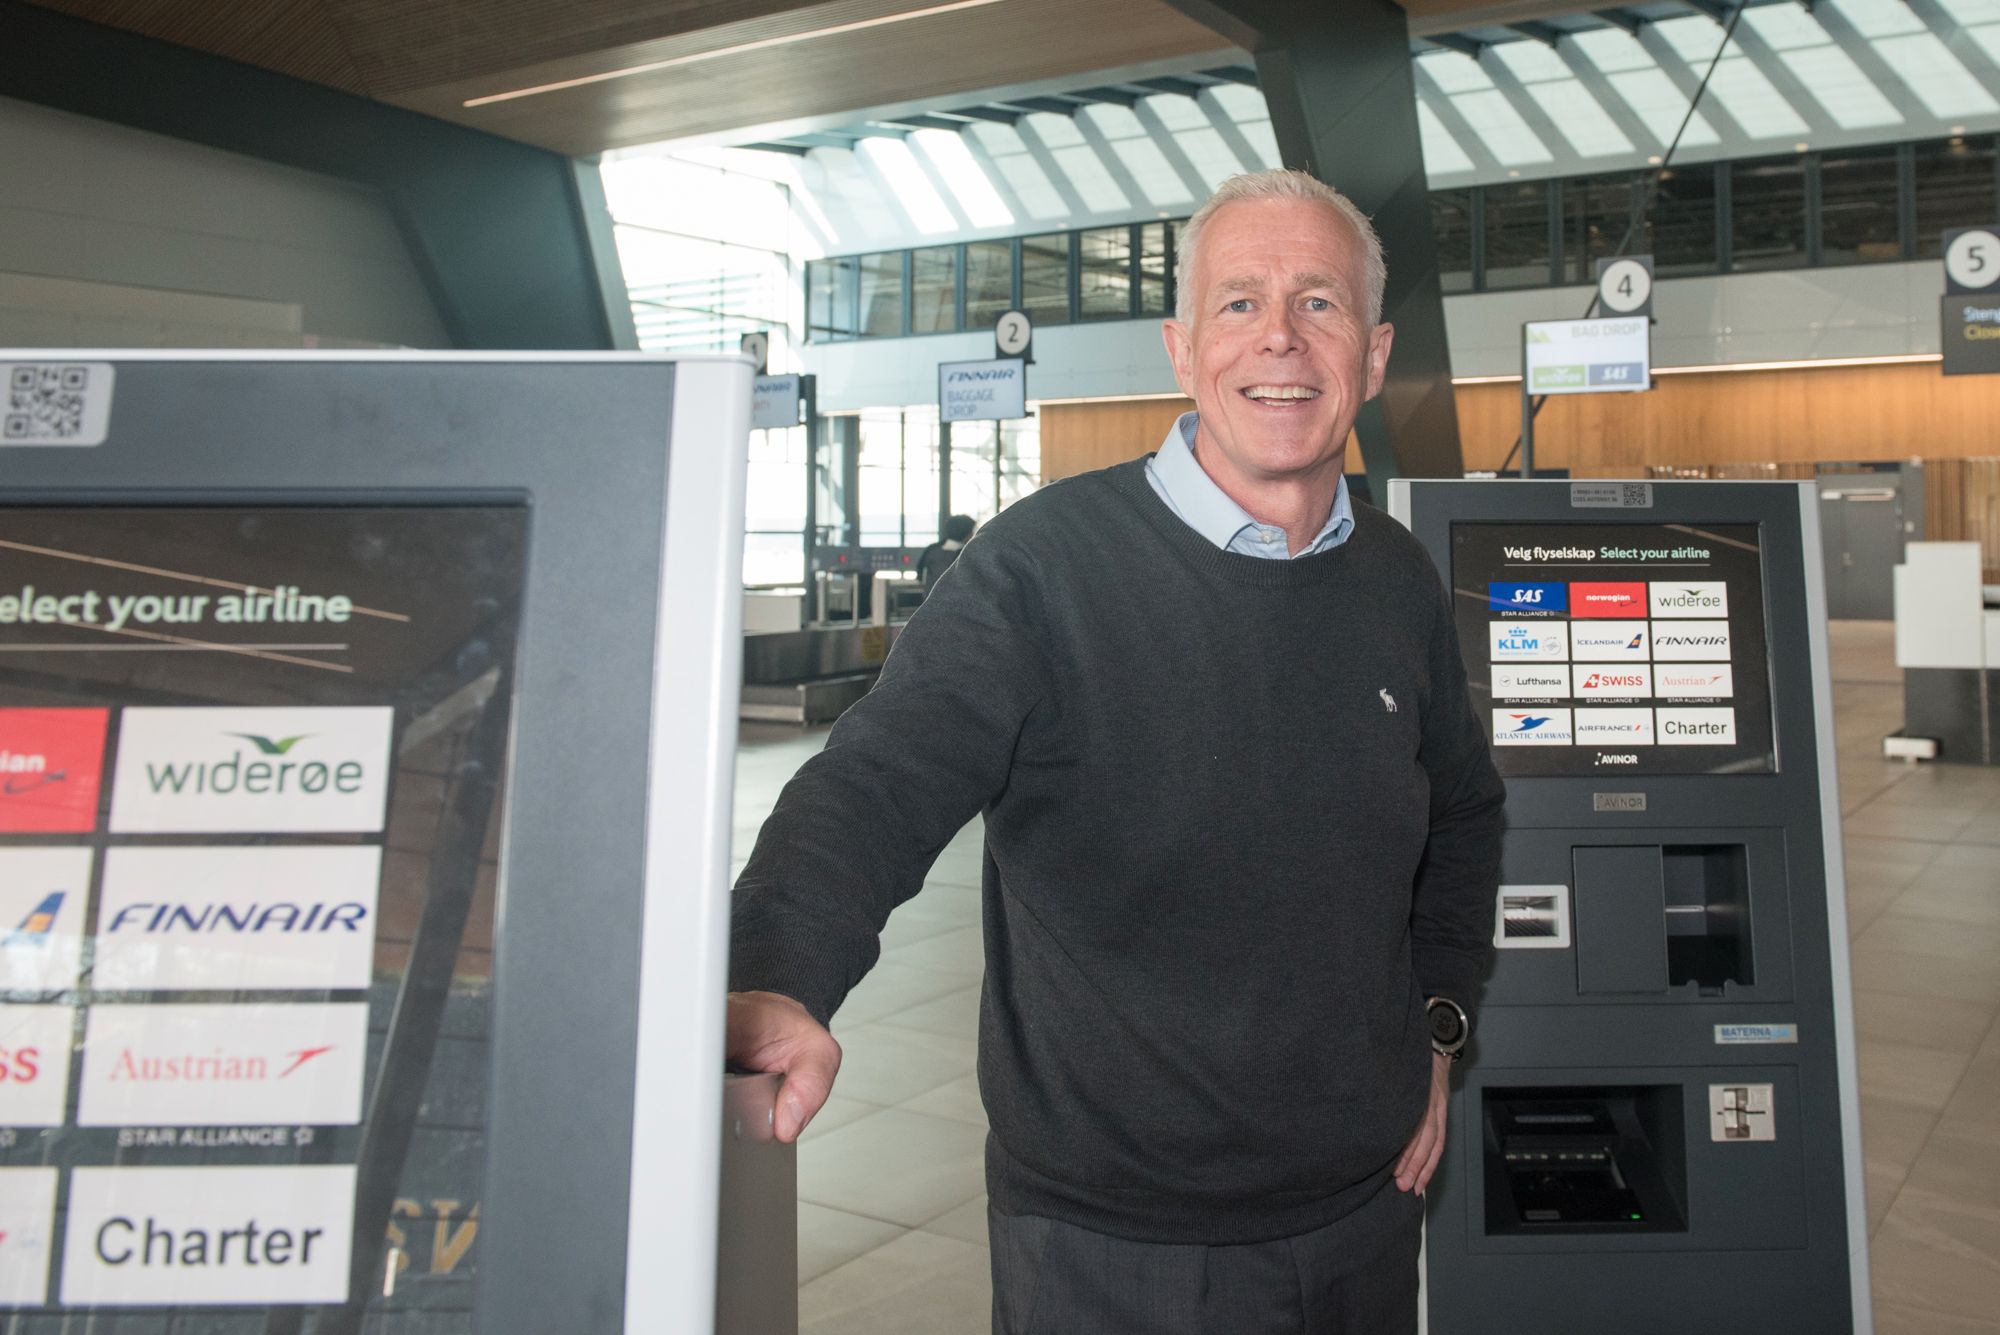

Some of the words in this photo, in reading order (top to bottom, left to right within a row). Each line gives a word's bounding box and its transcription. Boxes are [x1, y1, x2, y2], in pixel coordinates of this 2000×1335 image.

[1967, 245, 1985, 273] 5
[1617, 273, 1632, 298] 4
[1008, 322, 1019, 343] 2
[1571, 325, 1599, 338] BAG
[1603, 323, 1642, 336] DROP
[948, 367, 1015, 382] FINNAIR
[1602, 366, 1630, 380] SAS
[947, 388, 994, 402] BAGGAGE
[948, 404, 977, 418] DROP
[1504, 547, 1532, 561] Velg
[1533, 547, 1596, 561] flyselskap
[1600, 547, 1638, 559] Select
[1639, 549, 1669, 561] your
[1671, 547, 1710, 559] airline
[1511, 589, 1545, 603] SAS
[1586, 594, 1630, 603] norwegian
[1658, 594, 1721, 607] widerøe
[105, 594, 209, 632] your
[215, 585, 353, 623] airline
[1498, 639, 1538, 650] KLM
[1577, 638, 1623, 646] ICELANDAIR
[1656, 636, 1728, 646] FINNAIR
[1516, 677, 1562, 686] Lufthansa
[1602, 675, 1643, 686] SWISS
[1662, 676, 1706, 686] Austrian
[1665, 721, 1727, 735] Charter
[1601, 754, 1638, 765] AVINOR
[146, 751, 363, 793] widerøe
[1605, 798, 1643, 808] AVINOR
[107, 902, 367, 933] FINNAIR
[1721, 1027, 1771, 1036] MATERNA
[109, 1049, 267, 1080] Austrian
[117, 1128, 176, 1147] STAR
[180, 1127, 288, 1146] ALLIANCE
[95, 1216, 323, 1266] Charter
